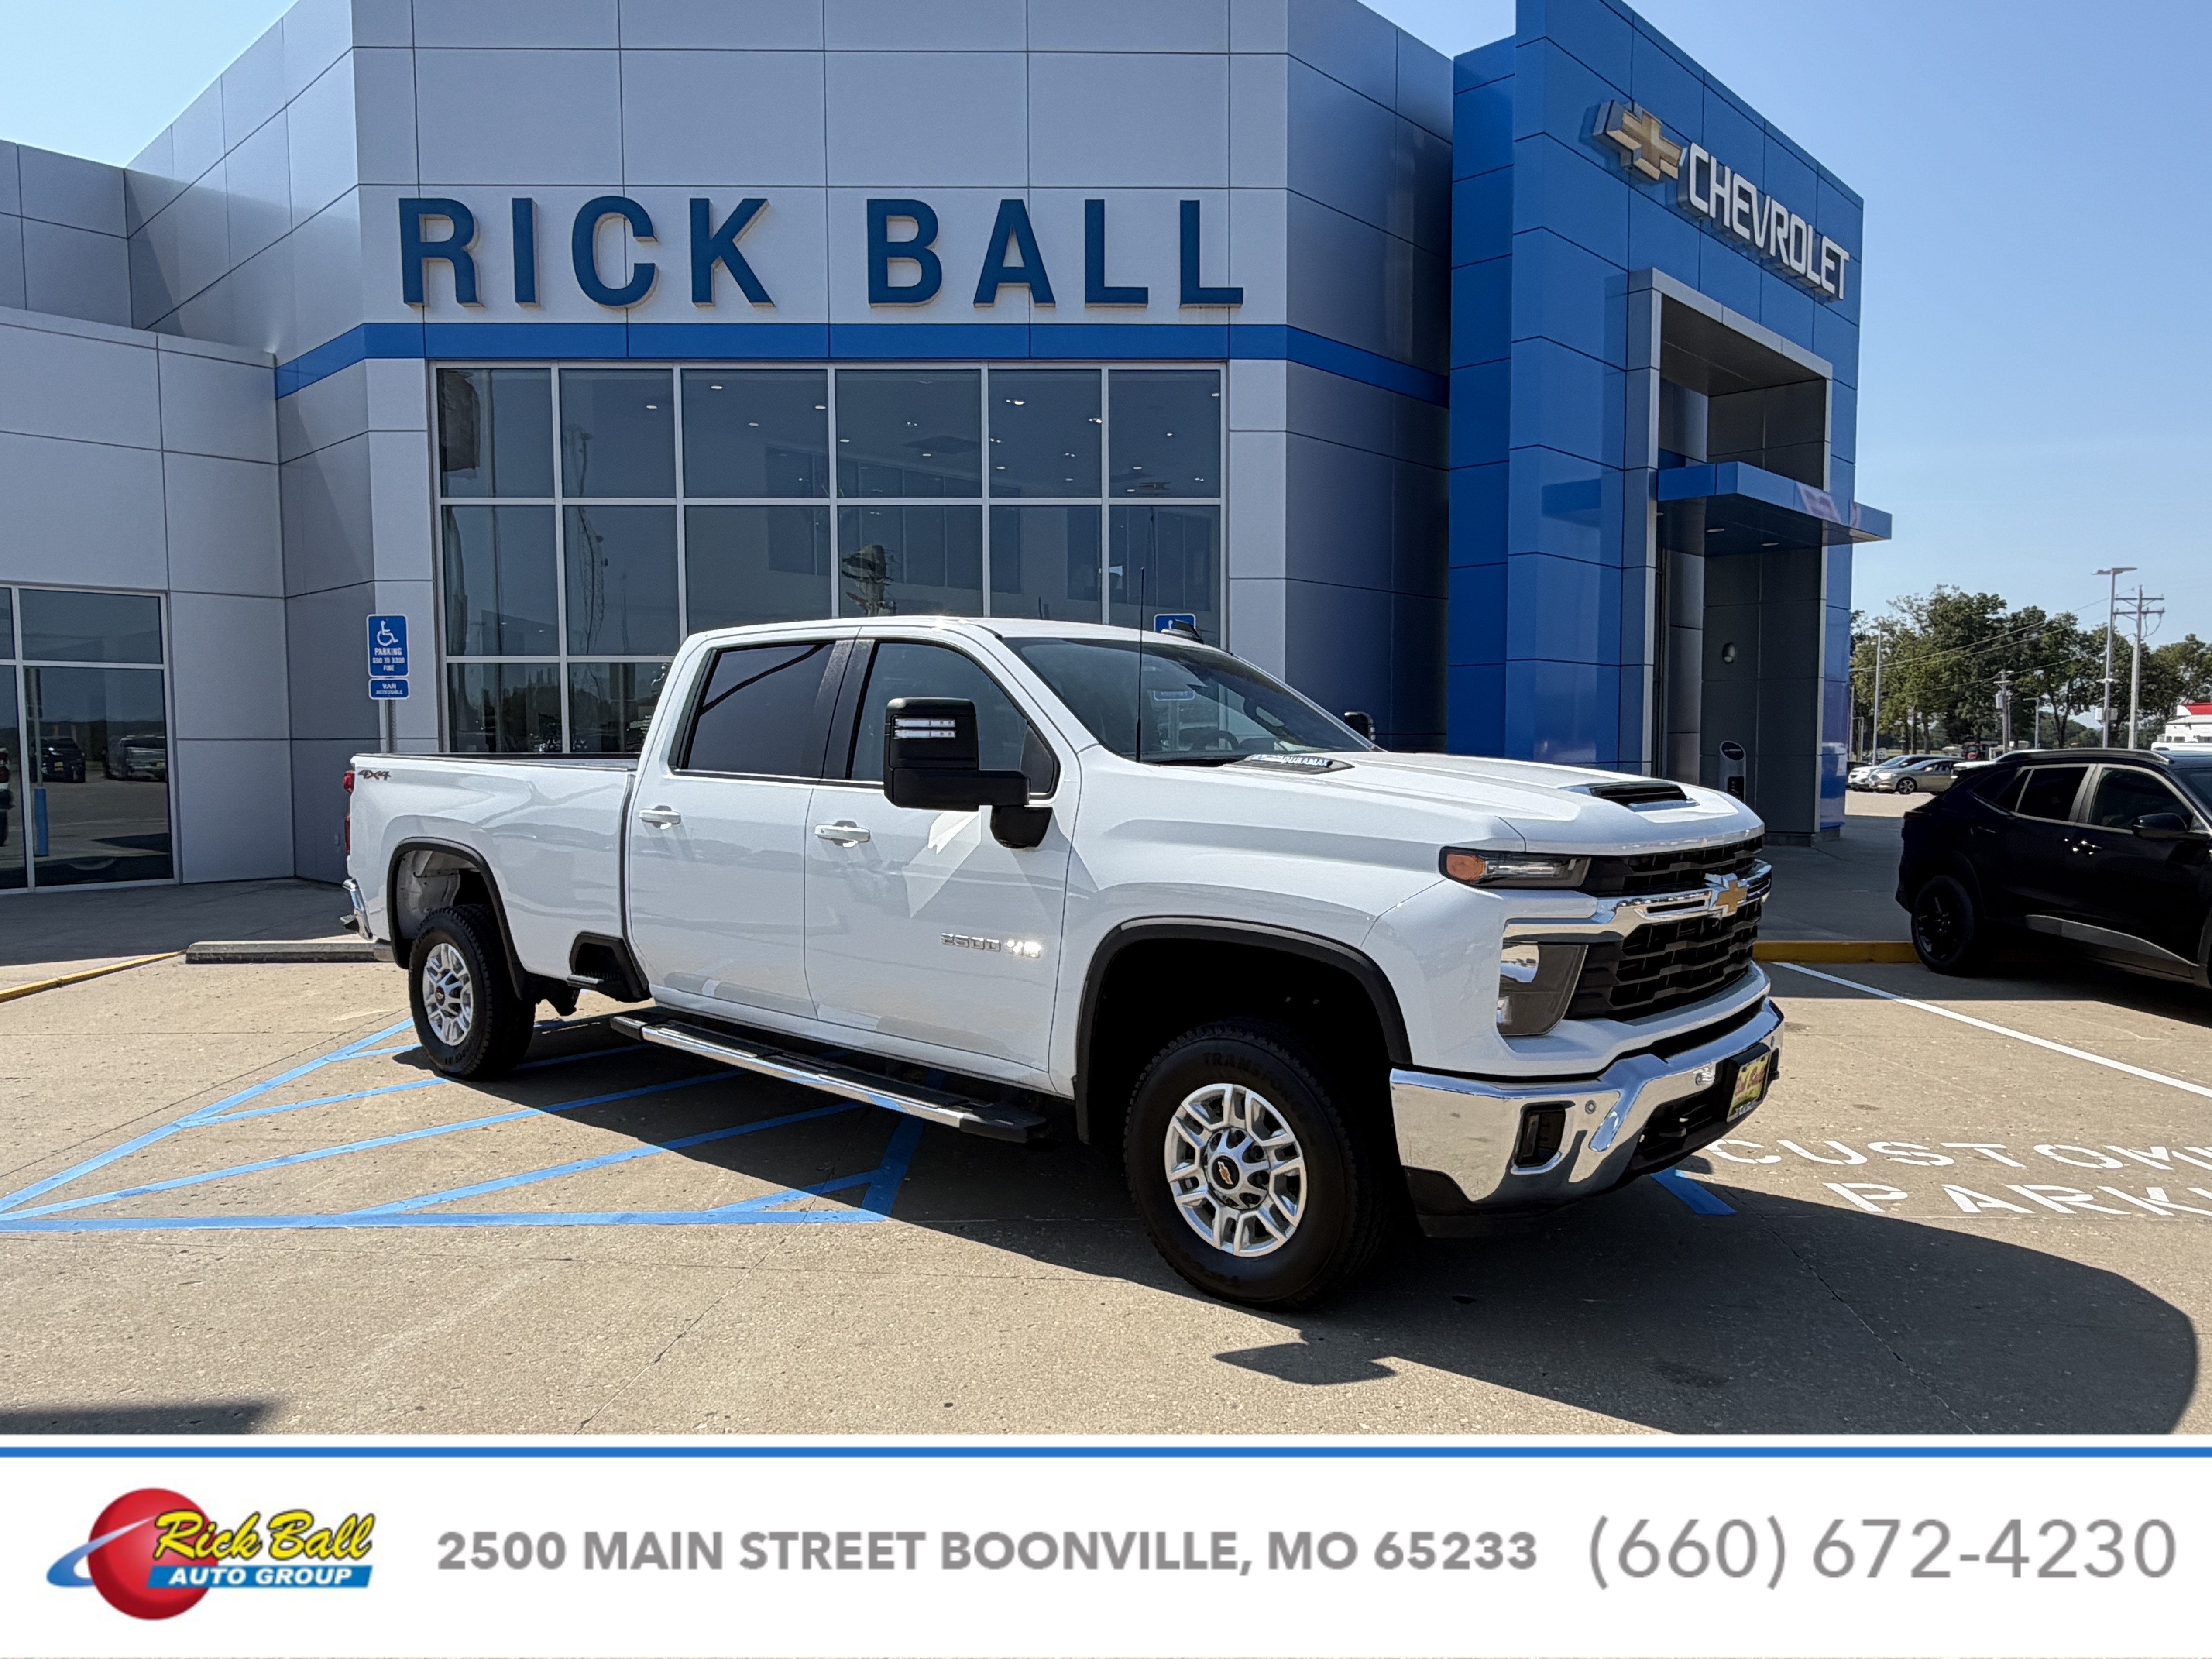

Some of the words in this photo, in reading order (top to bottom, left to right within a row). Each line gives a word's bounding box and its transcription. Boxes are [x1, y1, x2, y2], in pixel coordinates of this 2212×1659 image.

[1688, 142, 1850, 301] CHEVROLET
[398, 196, 776, 309] RICK
[867, 198, 1244, 308] BALL
[374, 647, 402, 656] PARKING
[1281, 756, 1329, 766] DURAMAX
[940, 932, 1001, 952] 2500
